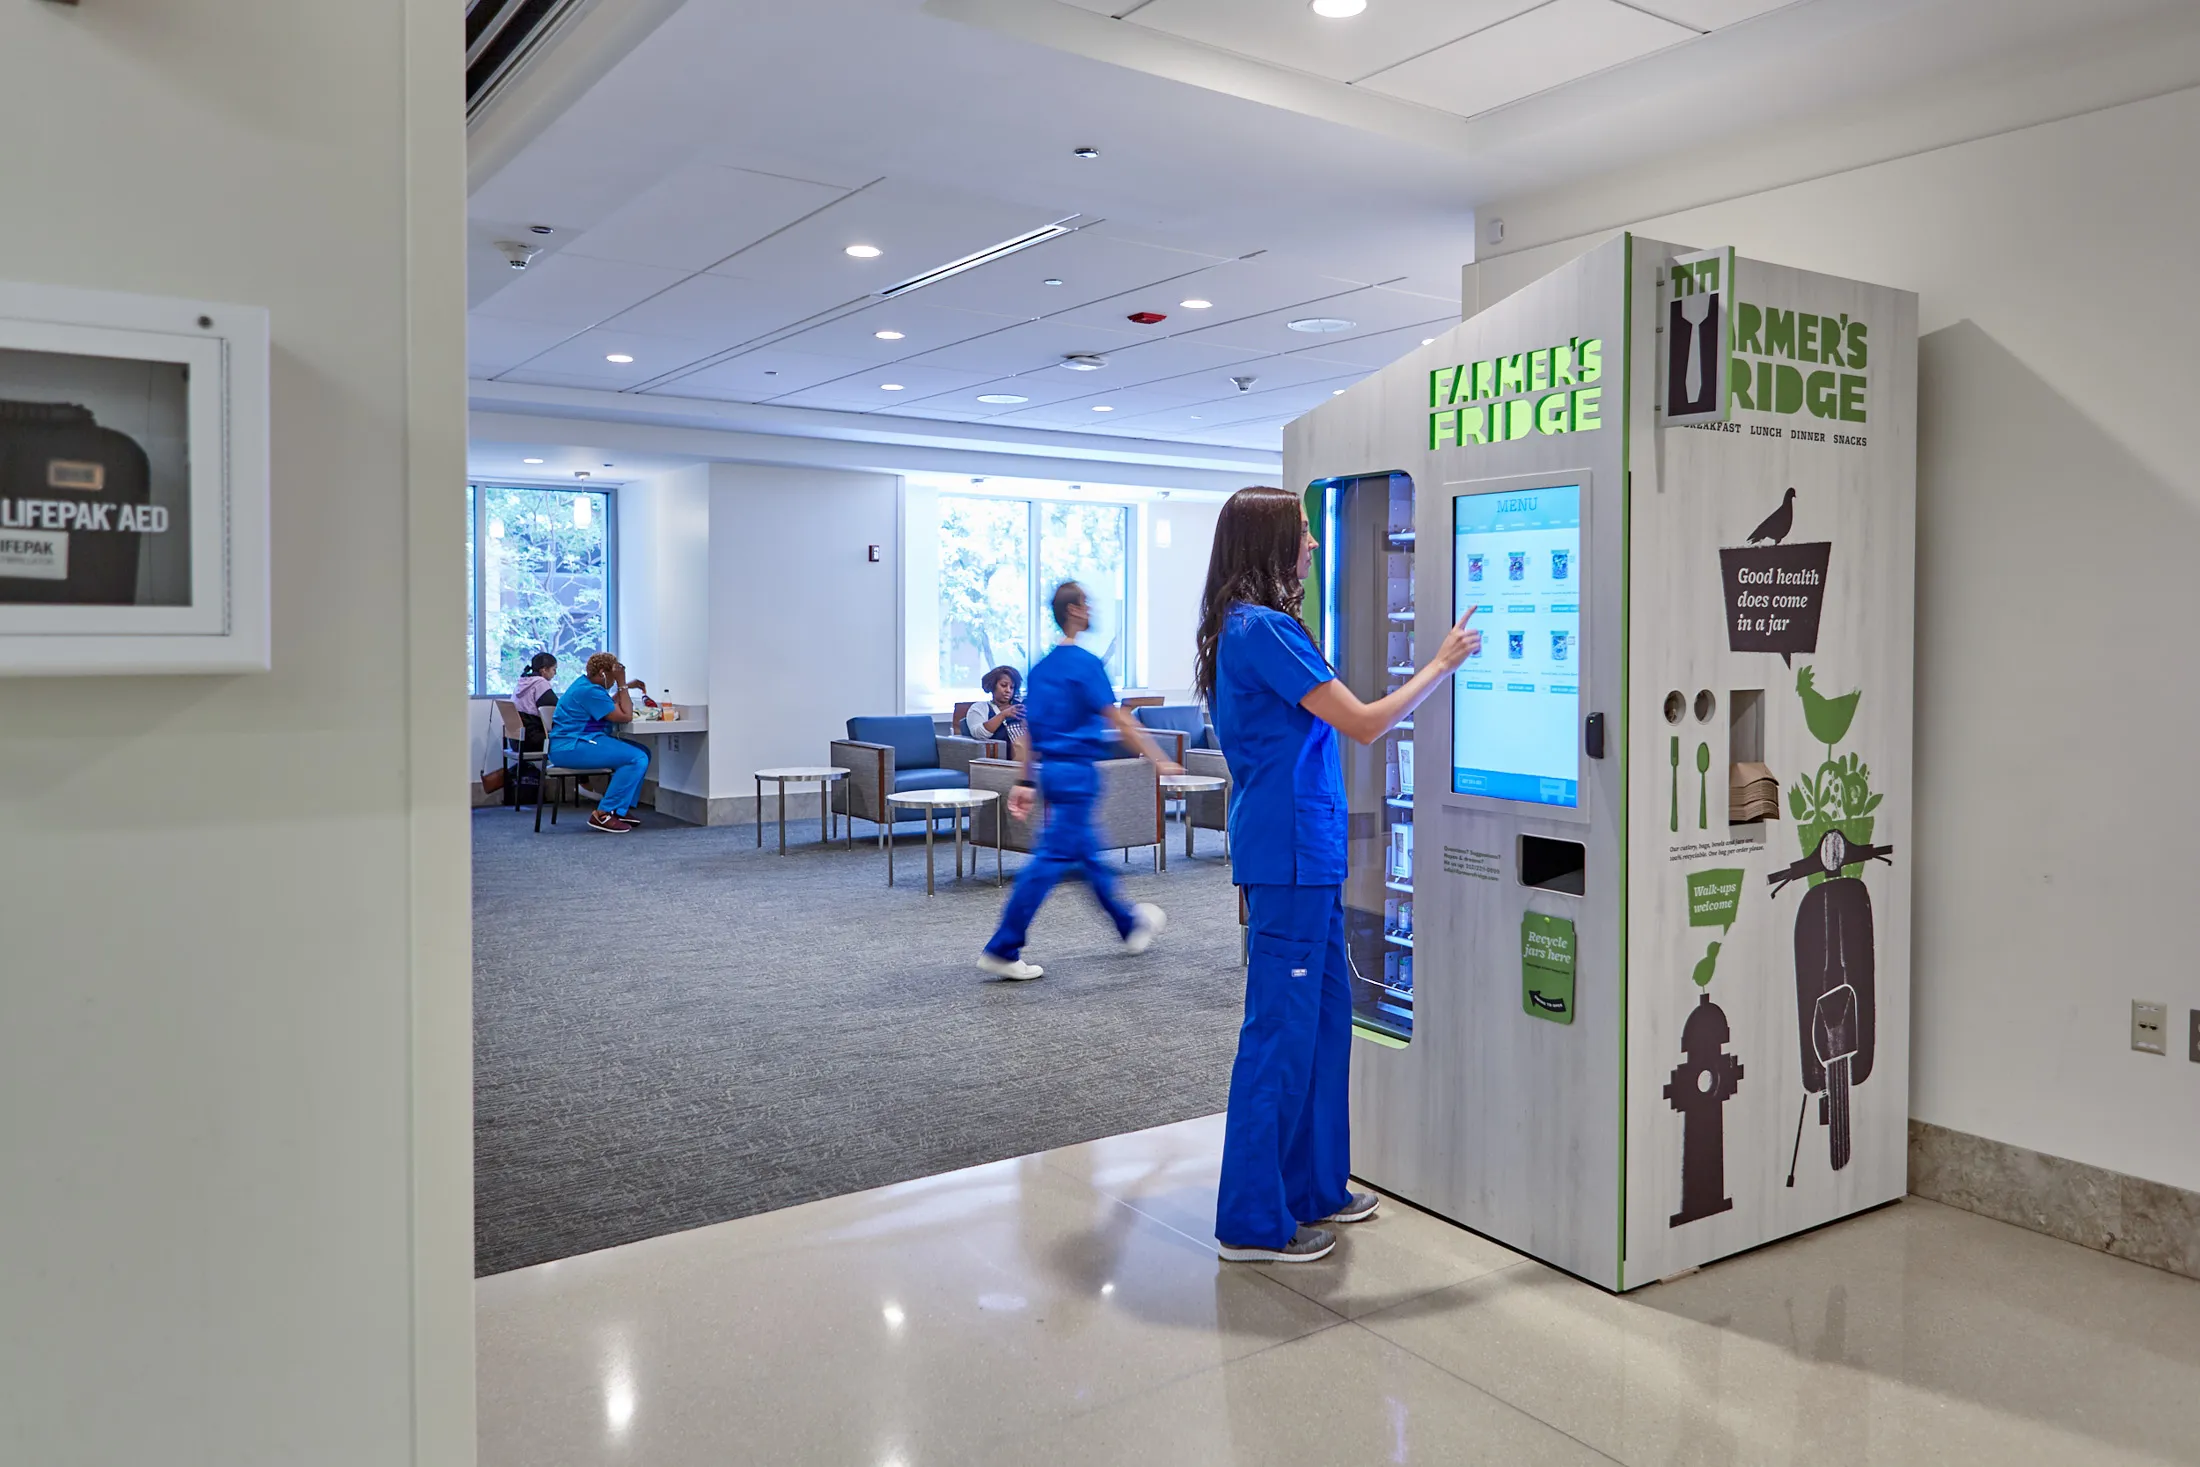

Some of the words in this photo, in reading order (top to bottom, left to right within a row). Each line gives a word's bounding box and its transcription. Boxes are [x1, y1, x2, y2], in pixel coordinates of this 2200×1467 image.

[1733, 302, 1867, 370] RMER'S
[1429, 336, 1602, 409] FARMER'S
[1731, 358, 1867, 423] RIDGE
[1429, 386, 1602, 451] FRIDGE
[1750, 425, 1782, 438] LUNCH
[1790, 429, 1826, 442] DINNER
[1833, 434, 1867, 447] SNACKS
[1496, 497, 1538, 513] MENU
[117, 503, 169, 533] AED
[0, 539, 54, 556] IFEPAK
[1738, 567, 1774, 585] Good
[1776, 567, 1819, 585] health
[1737, 590, 1770, 608] does
[1772, 595, 1808, 608] come
[1737, 613, 1752, 631] in
[1755, 618, 1765, 631] a
[1765, 613, 1790, 636] jar
[1693, 883, 1737, 897] Walk-ups
[1693, 899, 1733, 913] welcome
[1528, 931, 1568, 949] Recycle
[1523, 944, 1546, 959] jars
[1547, 948, 1572, 964] here
